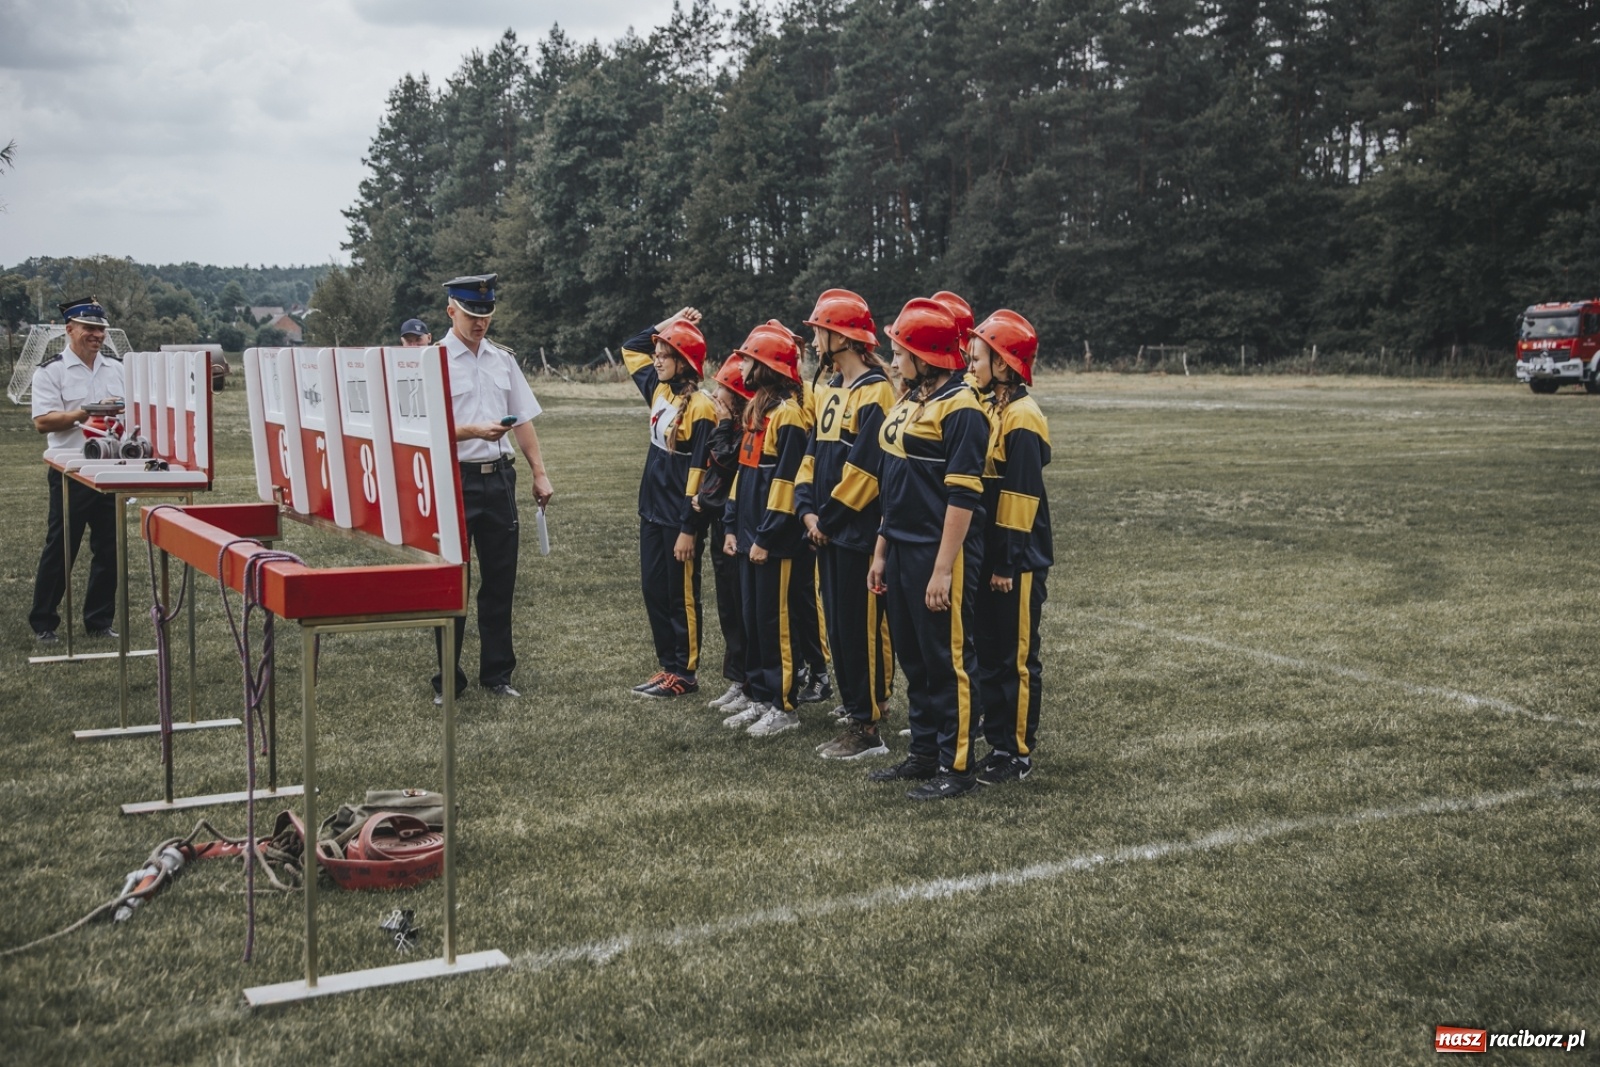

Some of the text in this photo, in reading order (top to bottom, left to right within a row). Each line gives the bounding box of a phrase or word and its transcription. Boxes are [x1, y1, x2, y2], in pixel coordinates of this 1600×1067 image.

[821, 394, 840, 434] 6
[884, 408, 908, 445] 8
[743, 431, 755, 459] 4
[360, 444, 376, 504] 8
[413, 451, 431, 518] 9
